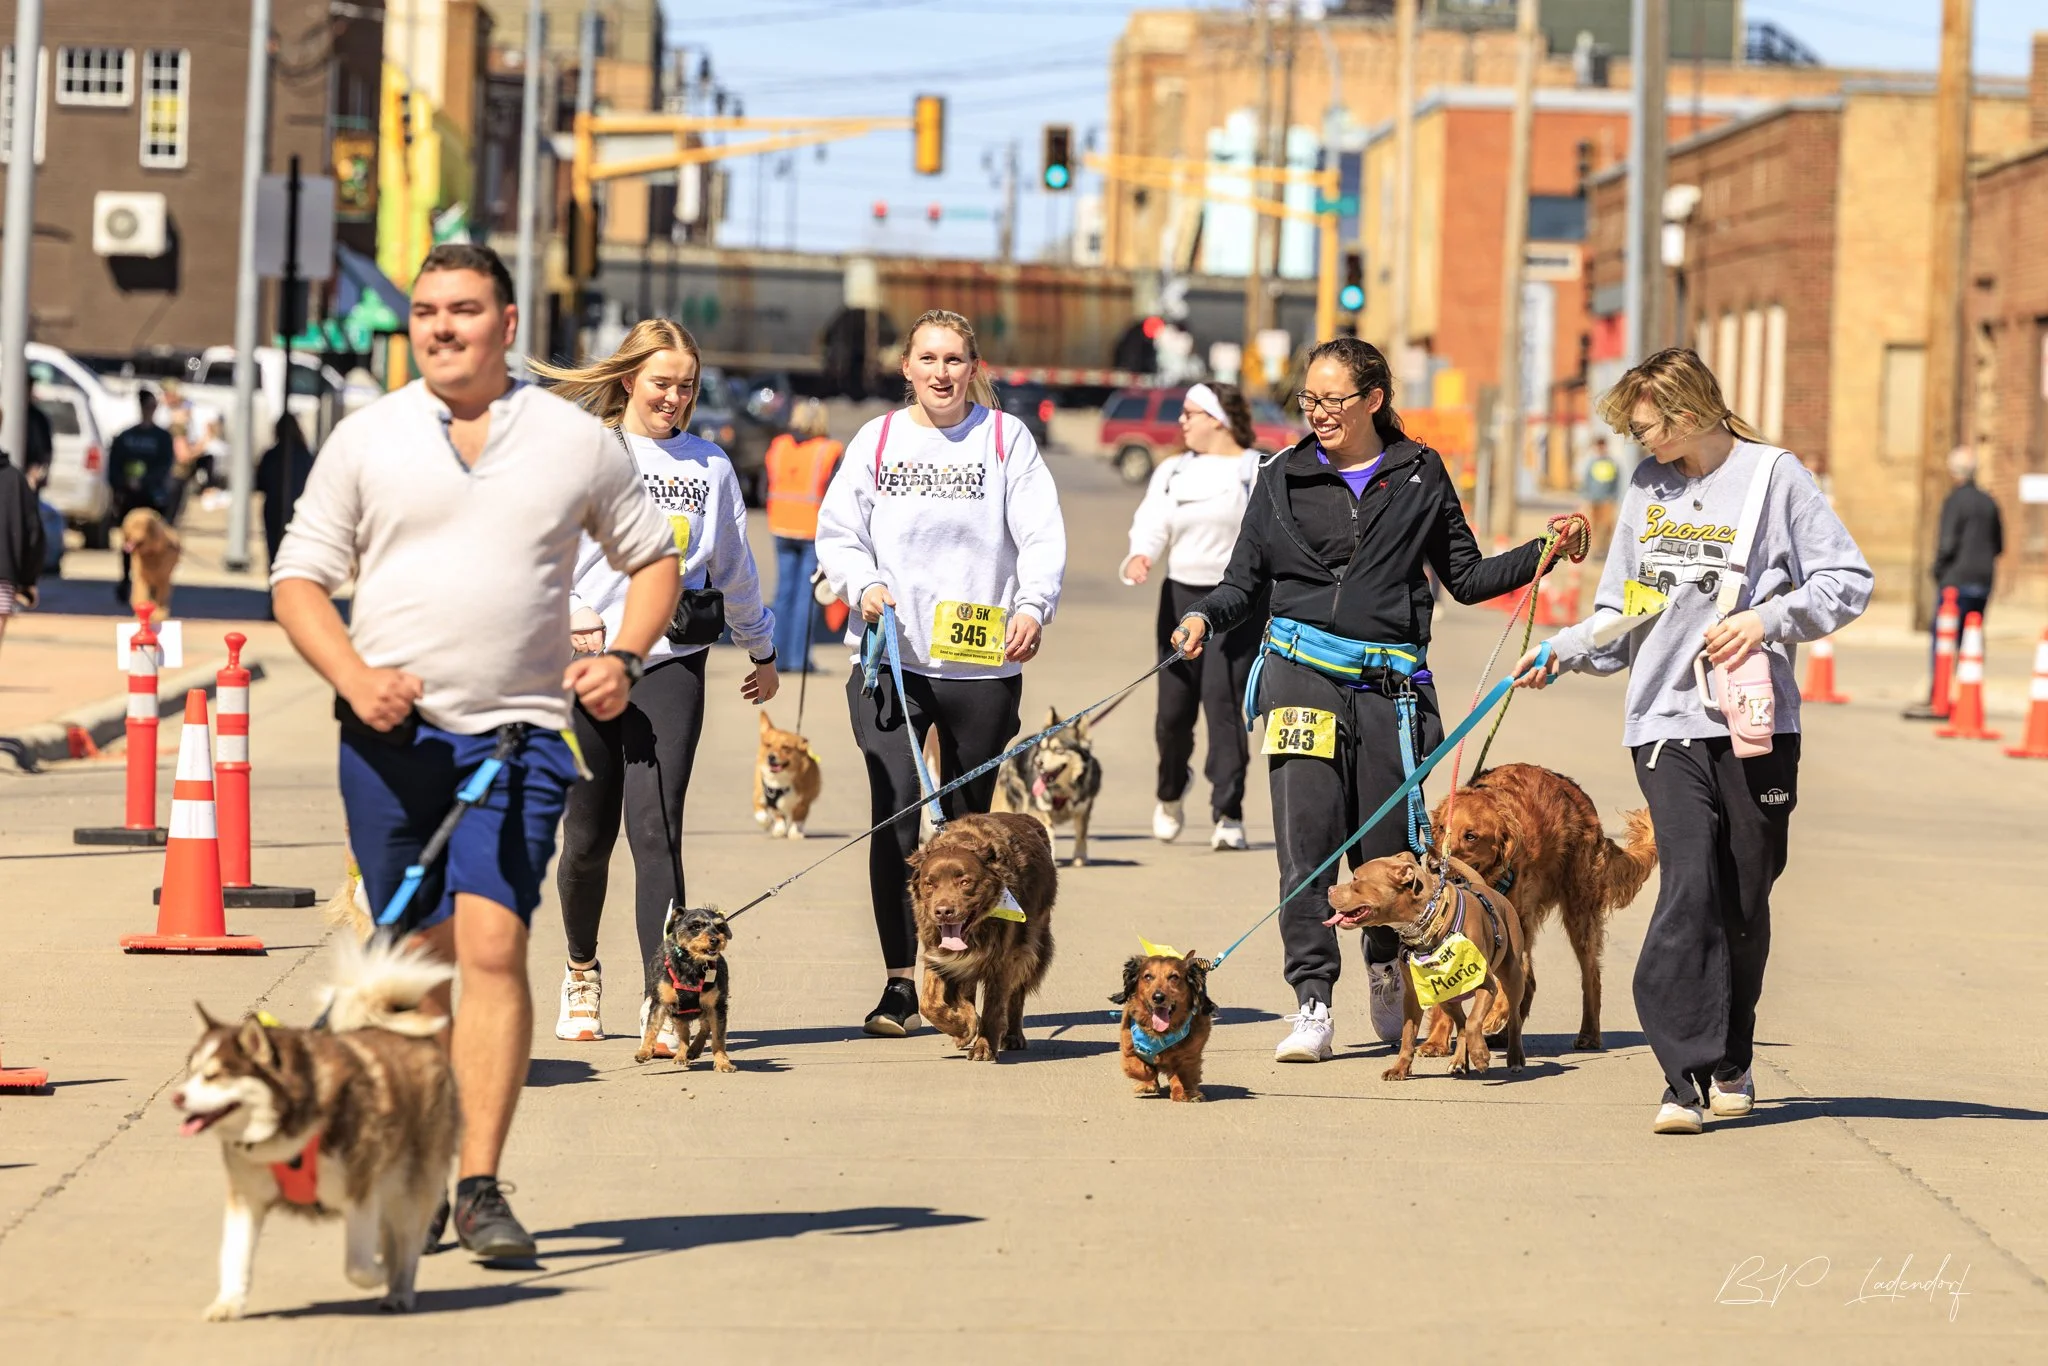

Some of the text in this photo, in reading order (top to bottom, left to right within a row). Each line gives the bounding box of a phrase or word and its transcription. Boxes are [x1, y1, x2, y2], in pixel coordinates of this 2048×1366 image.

[879, 473, 985, 486] VETERINARY
[648, 486, 709, 504] RINARY
[975, 607, 991, 621] 5K
[950, 622, 987, 648] 345
[1302, 711, 1318, 724] 5K
[1749, 697, 1772, 726] K
[1278, 728, 1315, 751] 343
[1760, 792, 1789, 803] OLD NAVY
[1438, 946, 1456, 963] 5K
[1430, 962, 1482, 996] Maria
